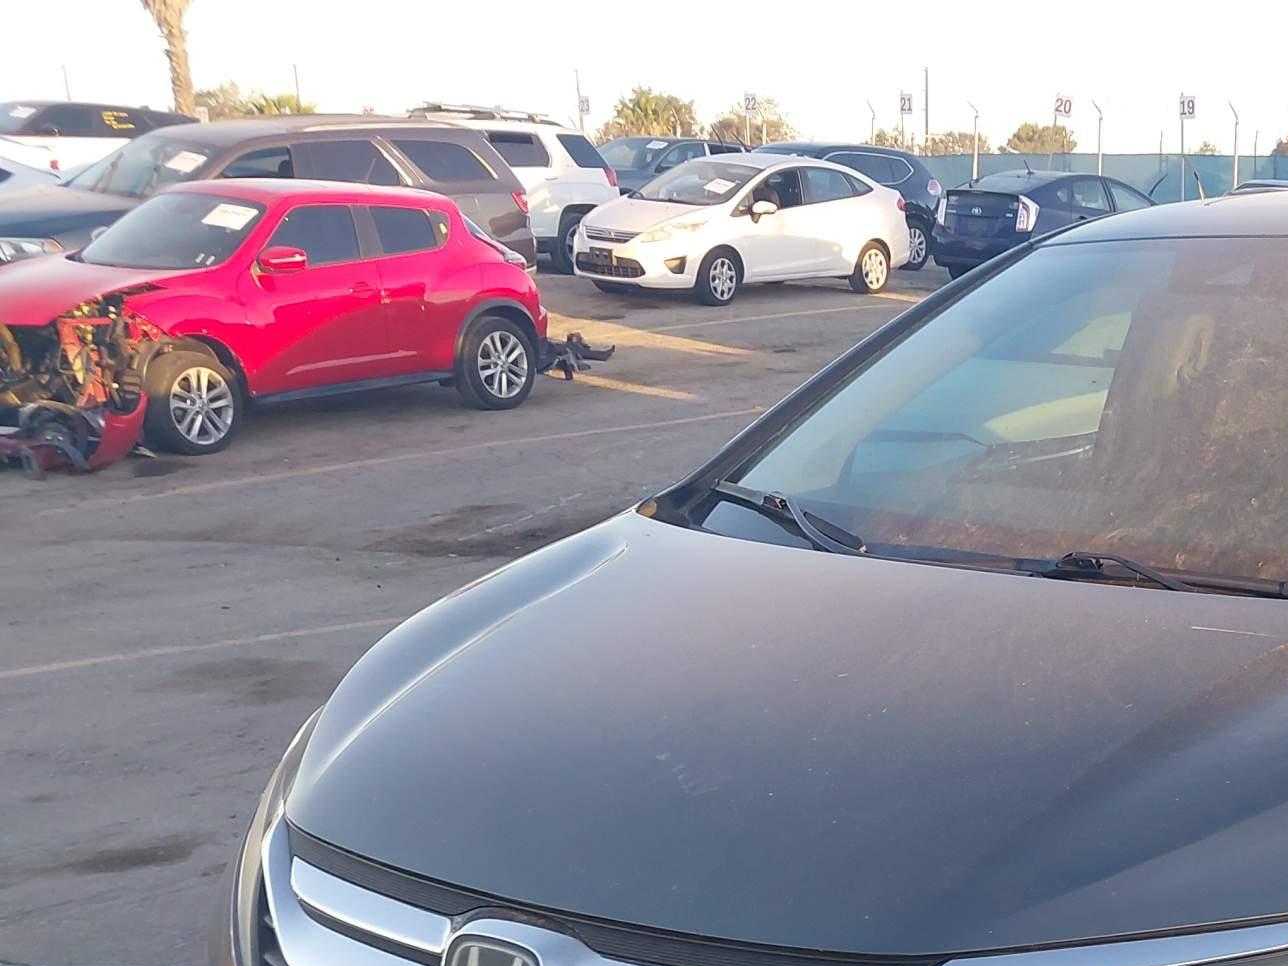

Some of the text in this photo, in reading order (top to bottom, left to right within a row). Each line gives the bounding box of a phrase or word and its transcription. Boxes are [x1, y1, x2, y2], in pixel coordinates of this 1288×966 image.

[745, 97, 757, 111] 22
[901, 97, 912, 111] 21
[1055, 98, 1072, 114] 20
[1180, 99, 1195, 115] 19
